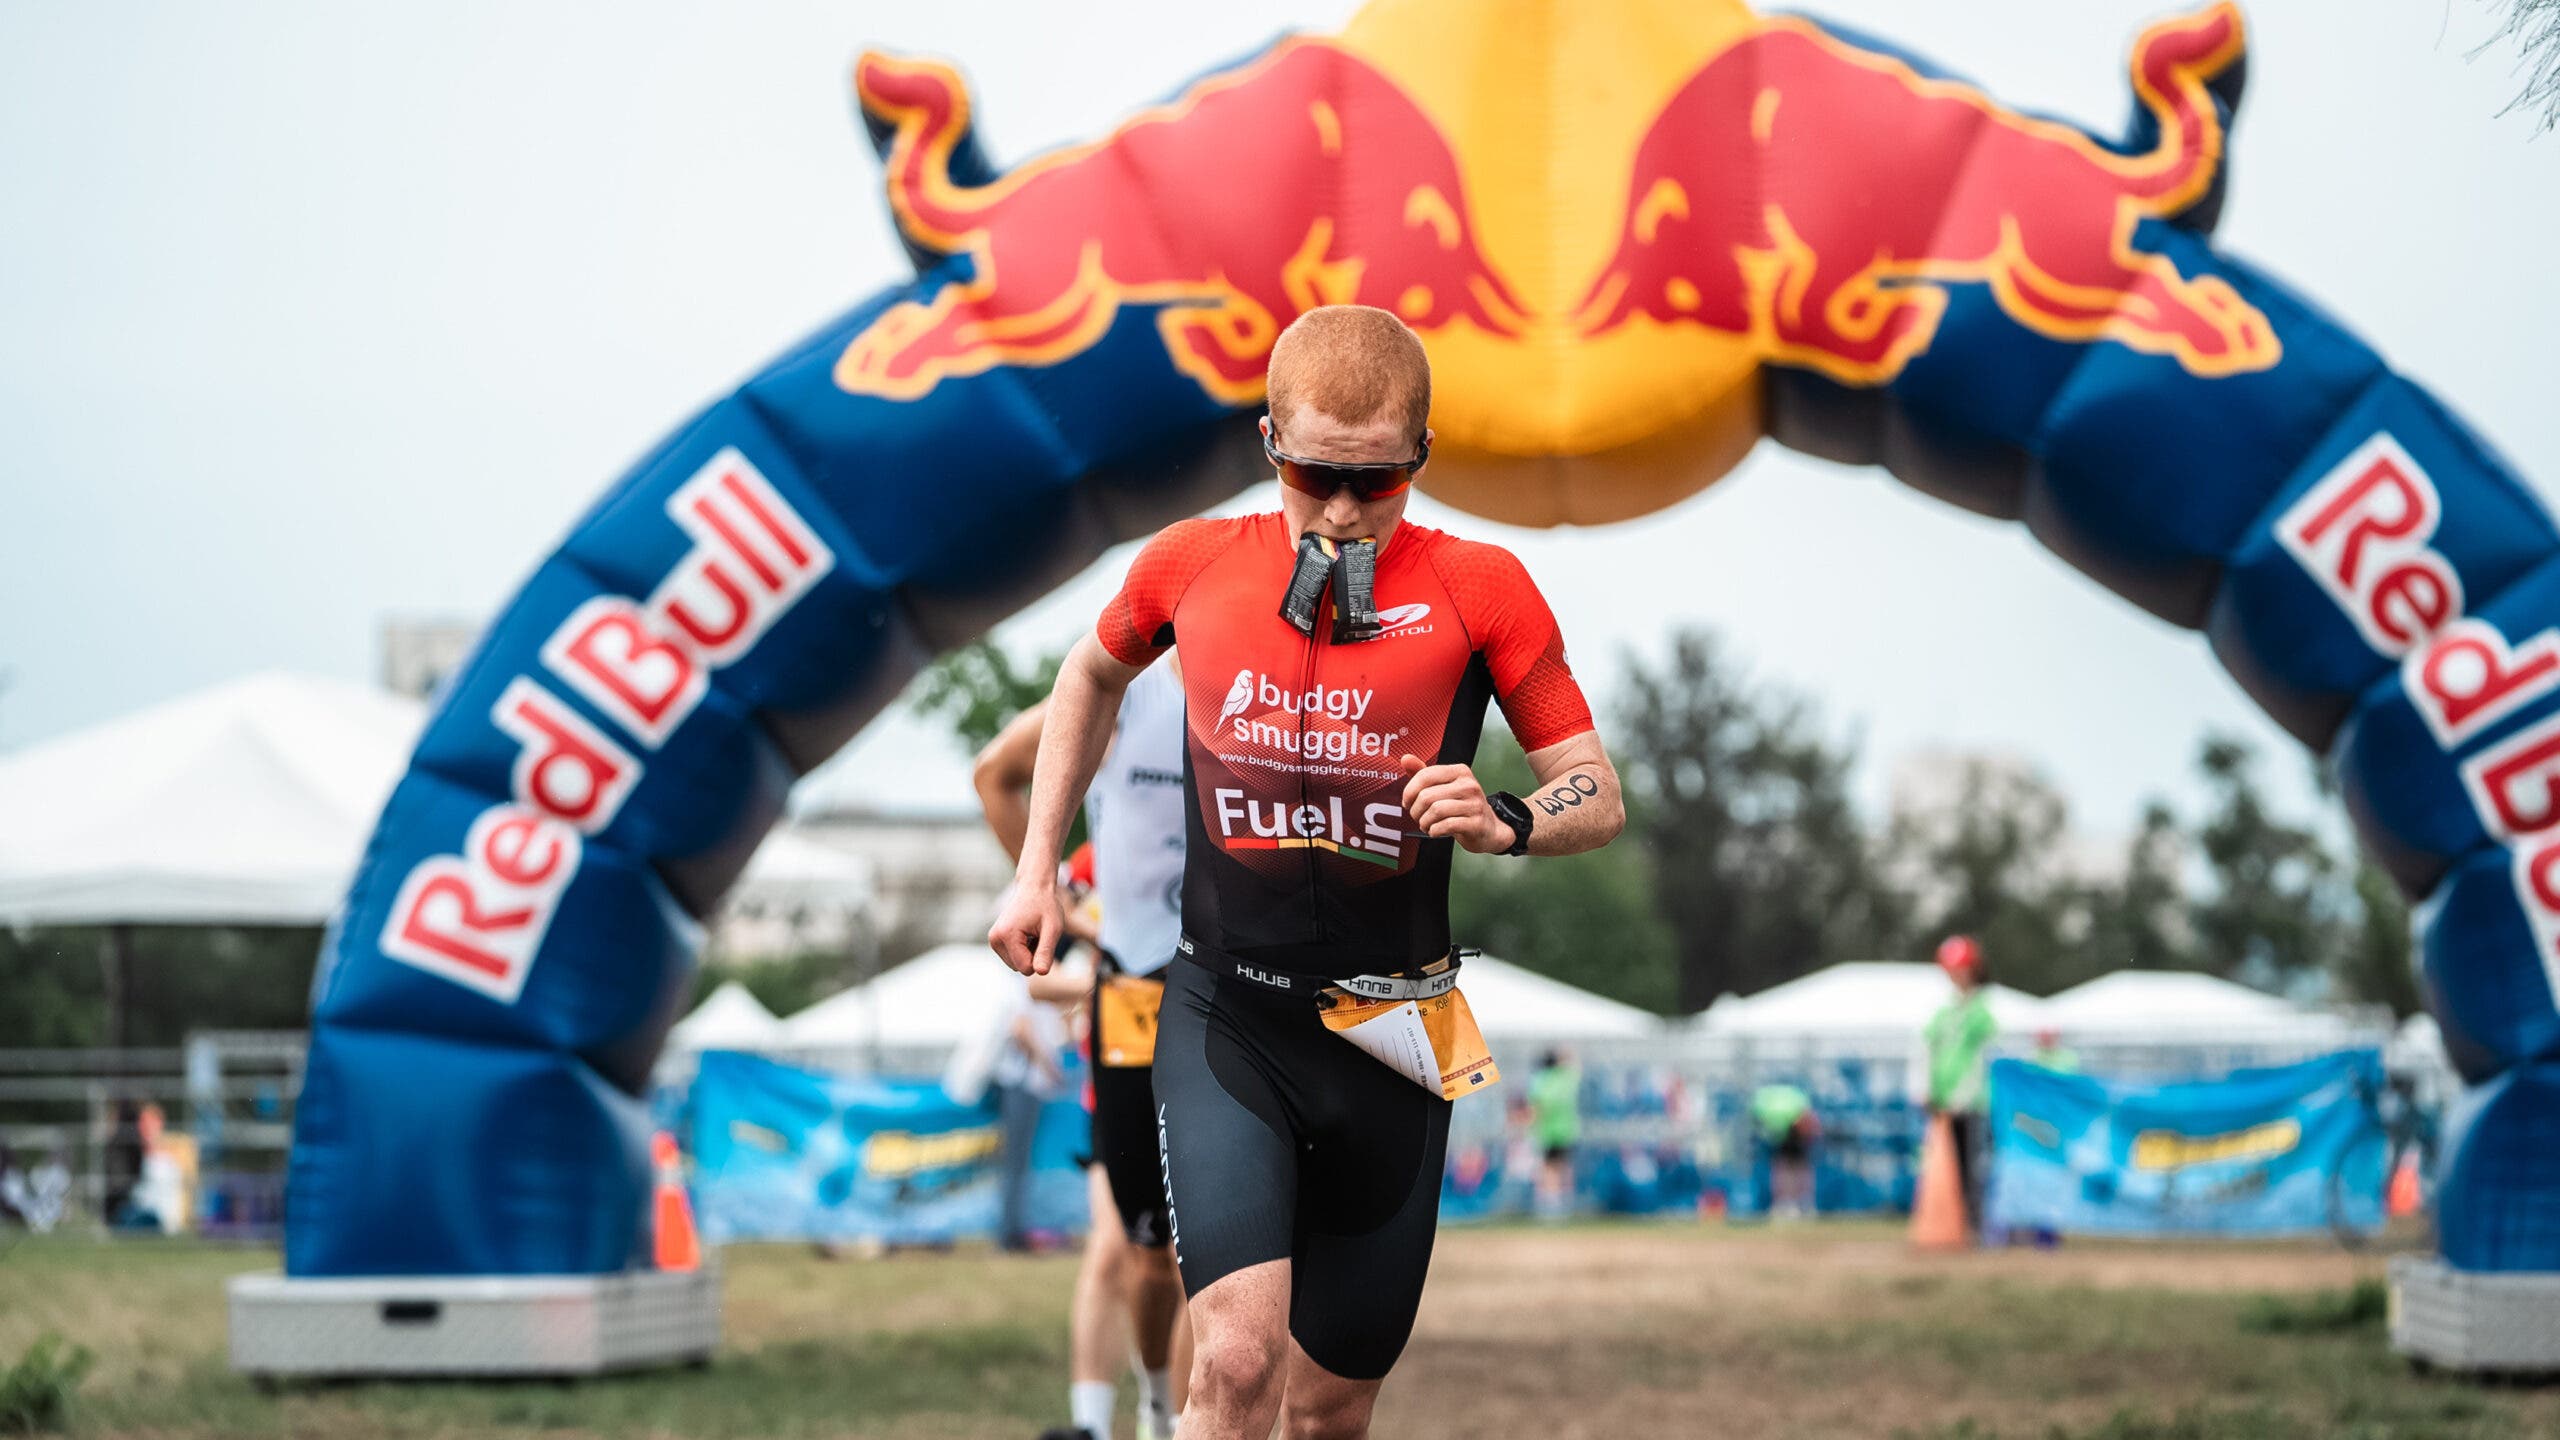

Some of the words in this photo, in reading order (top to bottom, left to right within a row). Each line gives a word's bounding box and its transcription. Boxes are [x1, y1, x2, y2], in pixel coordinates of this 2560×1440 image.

[2299, 456, 2560, 729] Red
[401, 698, 621, 982] Red
[565, 471, 812, 726] Bull
[1259, 673, 1373, 720] budgy
[1237, 964, 1291, 989] HUUB
